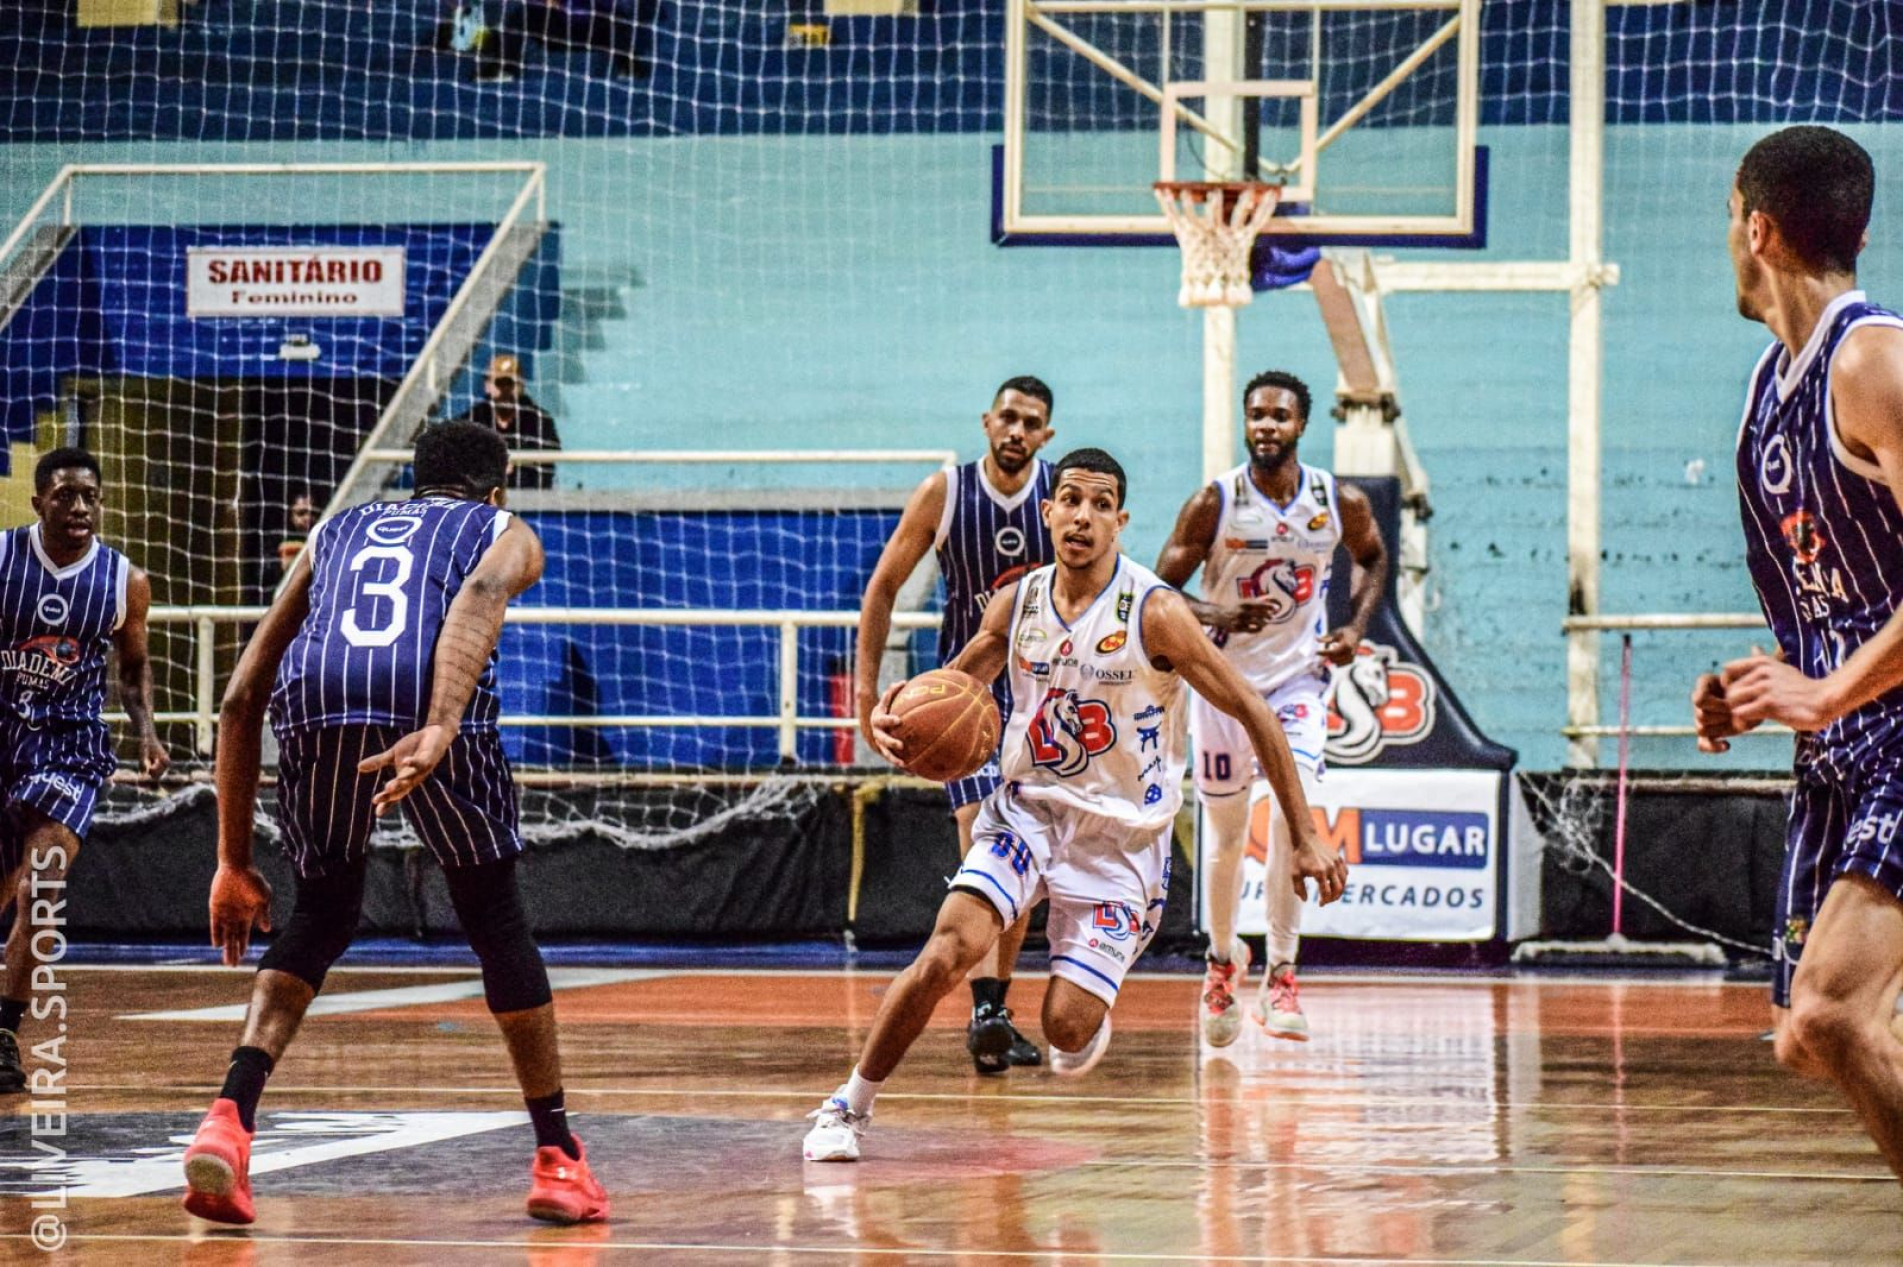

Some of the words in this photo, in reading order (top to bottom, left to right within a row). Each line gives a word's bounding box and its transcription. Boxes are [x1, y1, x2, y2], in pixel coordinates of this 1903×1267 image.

[208, 255, 383, 284] SANITÁRIO
[232, 291, 358, 305] Feminino
[340, 545, 415, 647] 3
[1203, 751, 1232, 780] 10
[1365, 822, 1486, 857] LUGAR
